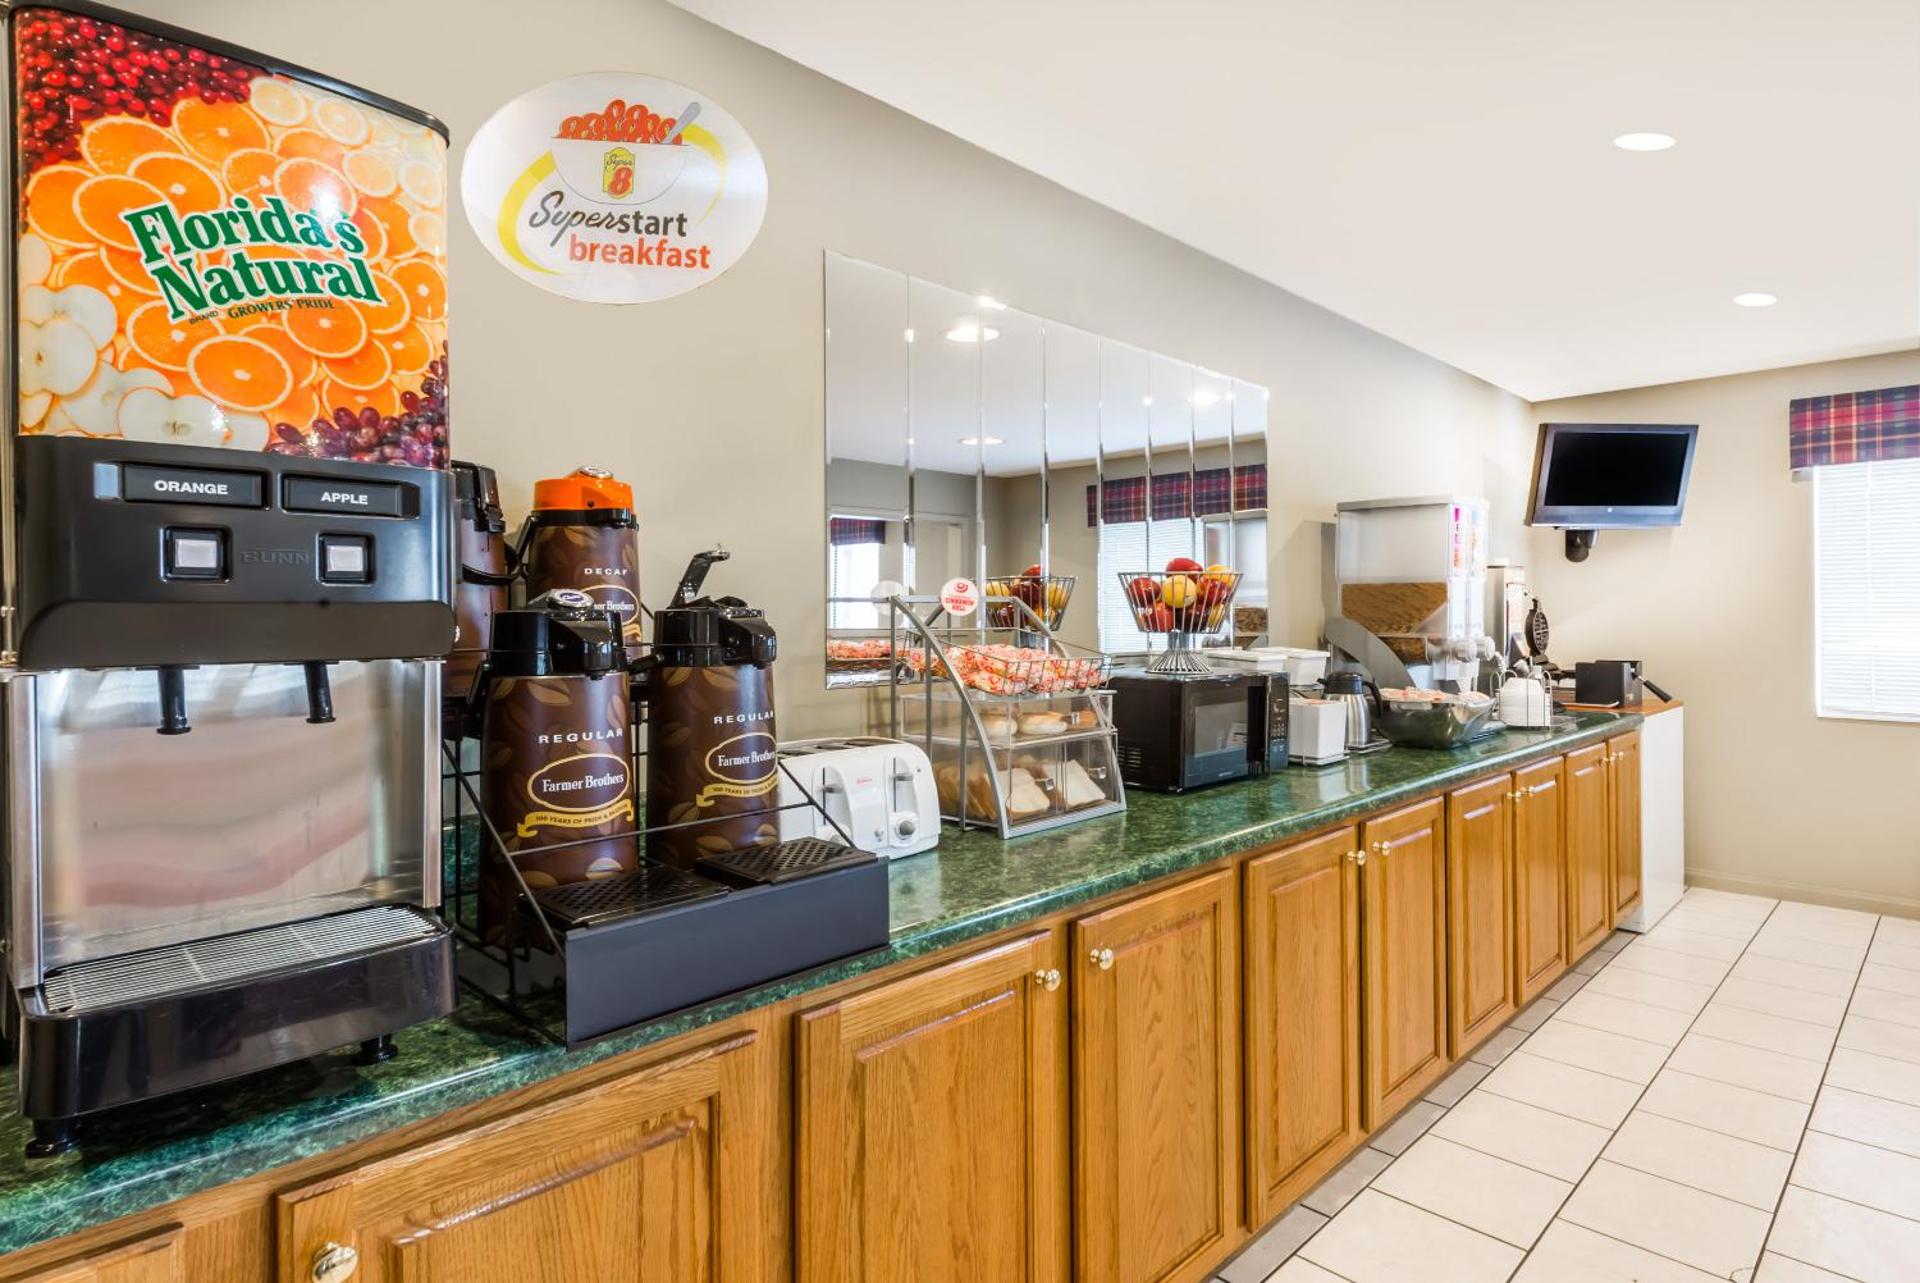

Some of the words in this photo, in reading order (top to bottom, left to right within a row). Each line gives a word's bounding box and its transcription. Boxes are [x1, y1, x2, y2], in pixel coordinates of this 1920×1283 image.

[610, 166, 633, 195] 8
[528, 190, 688, 247] Superstart
[569, 234, 711, 269] breakfast
[151, 251, 382, 320] Natural
[296, 299, 335, 310] PRIDE
[153, 479, 229, 496] ORANGE
[320, 491, 369, 505] APPLE
[241, 551, 310, 566] BUNN
[584, 567, 628, 576] DECAF
[538, 728, 623, 744] REGULAR
[718, 754, 750, 767] Farmer
[542, 779, 584, 793] Farmer
[585, 773, 625, 789] Brothers
